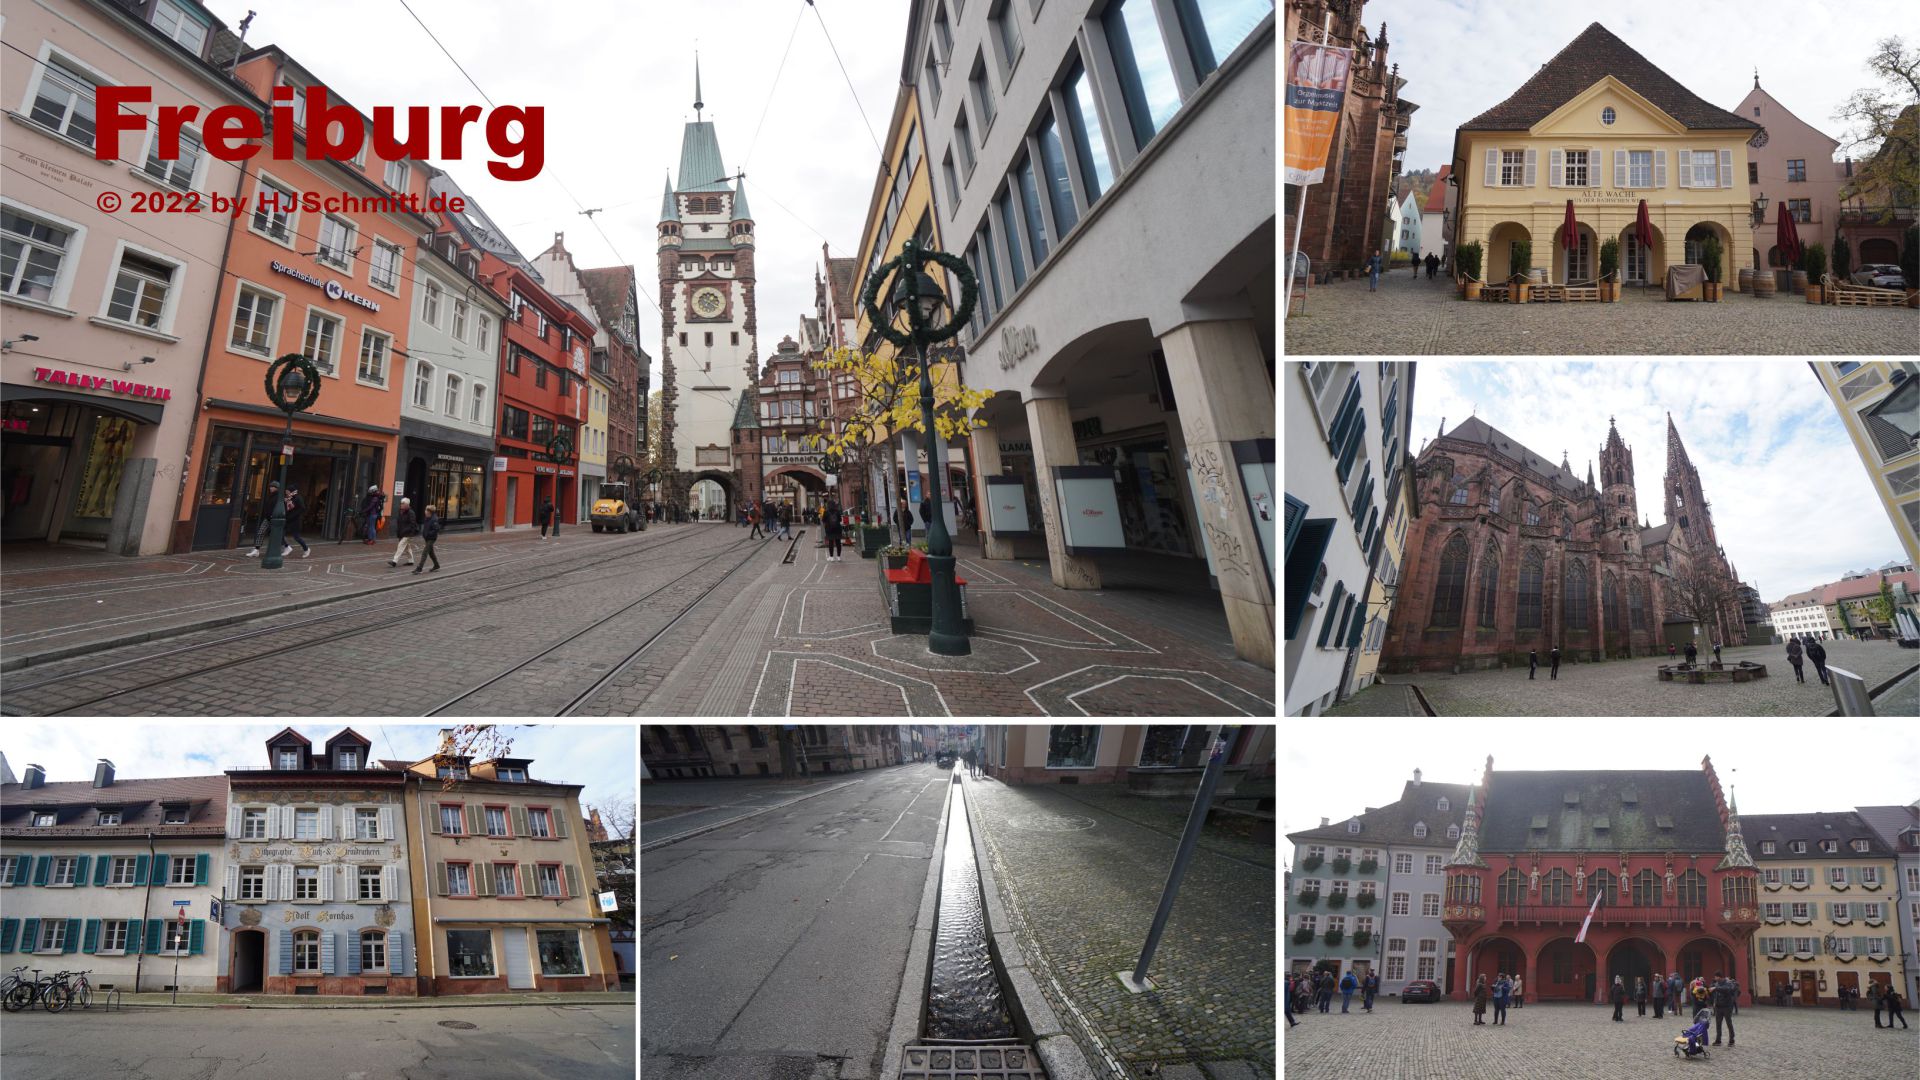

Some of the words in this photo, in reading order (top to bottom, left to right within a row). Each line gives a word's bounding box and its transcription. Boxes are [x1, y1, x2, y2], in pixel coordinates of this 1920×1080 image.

[273, 260, 324, 287] Sprachschule
[343, 290, 379, 311] KERN
[34, 367, 107, 389] TALLY
[771, 455, 818, 463] McDonald's
[284, 910, 310, 923] Adolf
[317, 910, 354, 923] Kornhas
